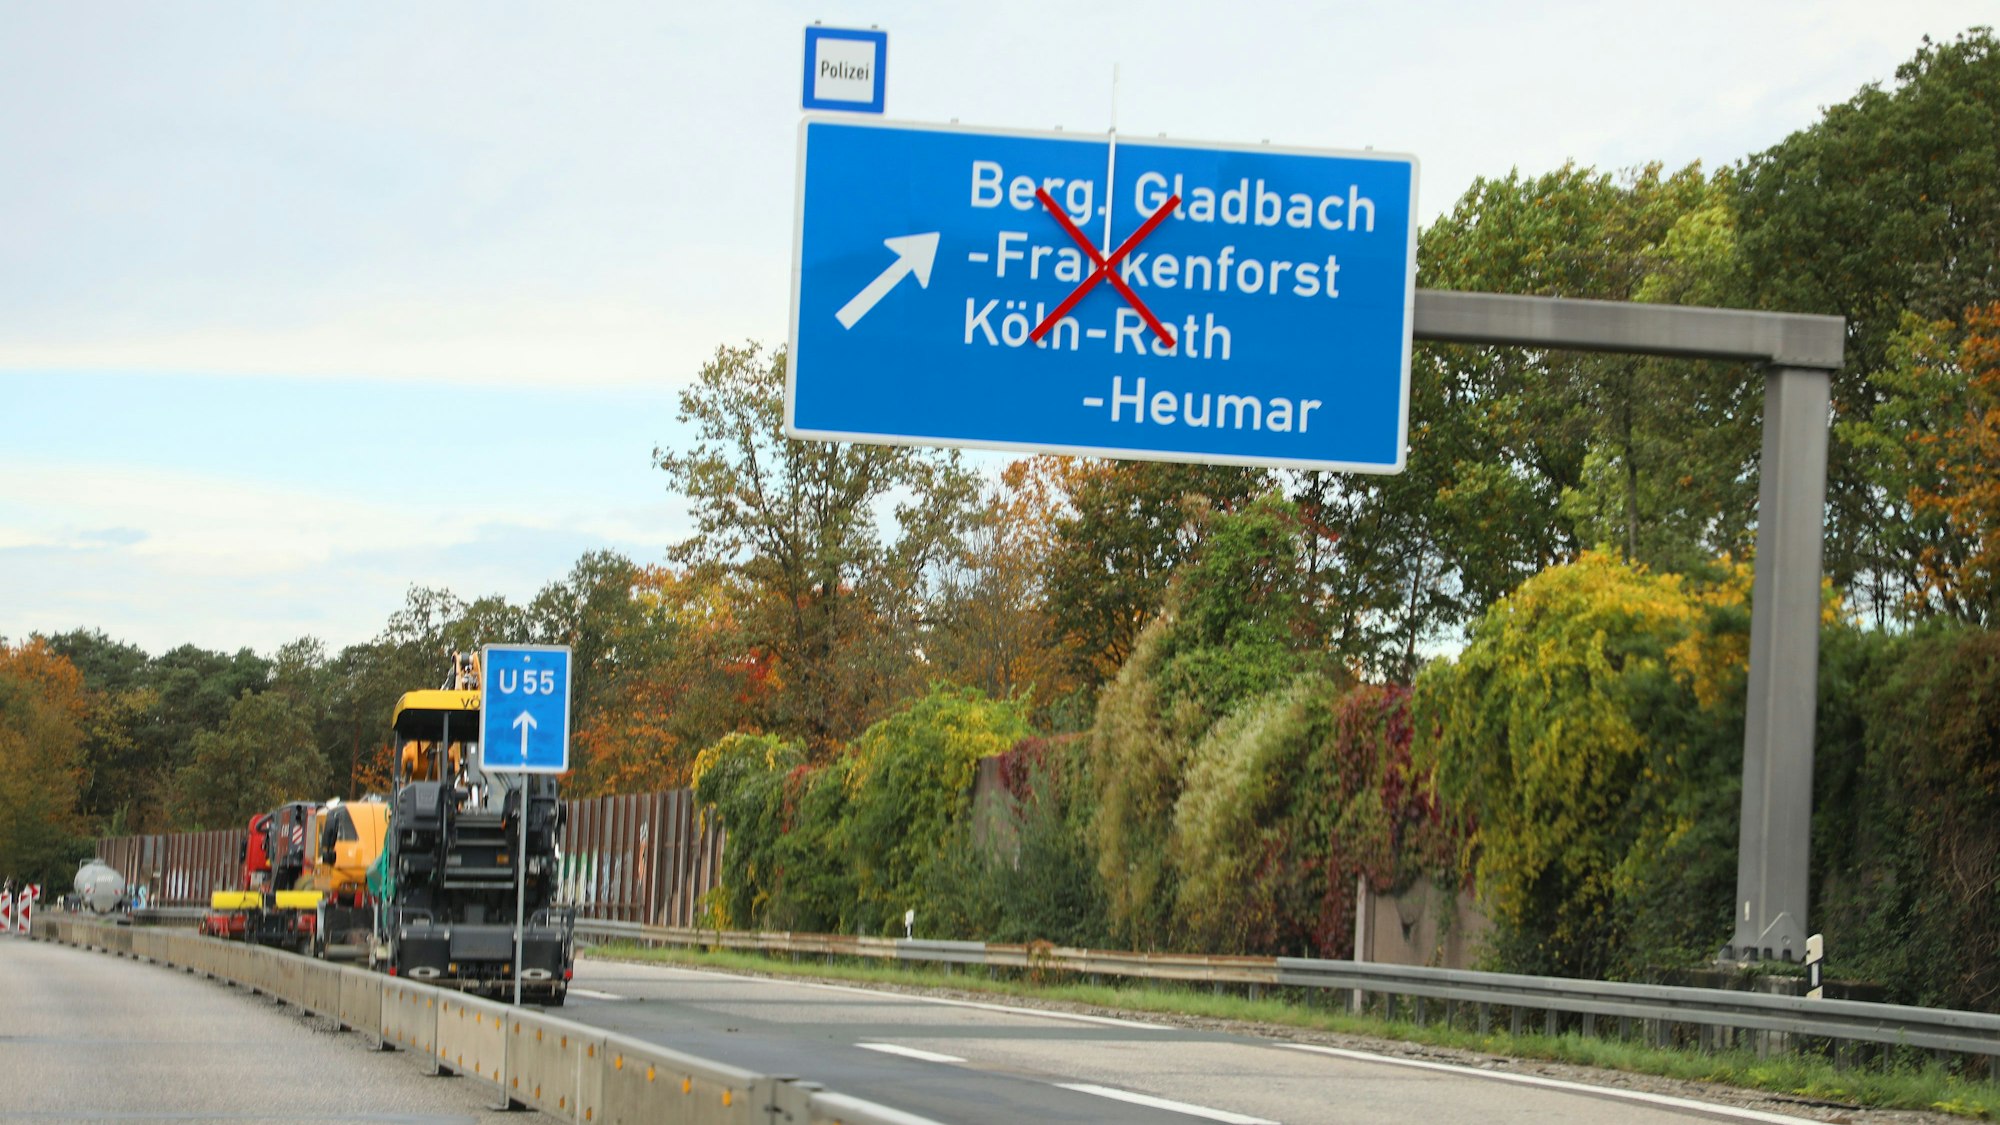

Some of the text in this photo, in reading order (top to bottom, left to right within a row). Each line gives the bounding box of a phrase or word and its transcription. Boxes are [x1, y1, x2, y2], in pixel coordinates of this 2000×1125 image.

[820, 60, 870, 81] Polizei
[970, 160, 1376, 232] Berg. Gladbach
[964, 297, 1232, 360] Köln-Rath
[1083, 376, 1322, 433] -Heumar
[499, 669, 555, 695] U 55
